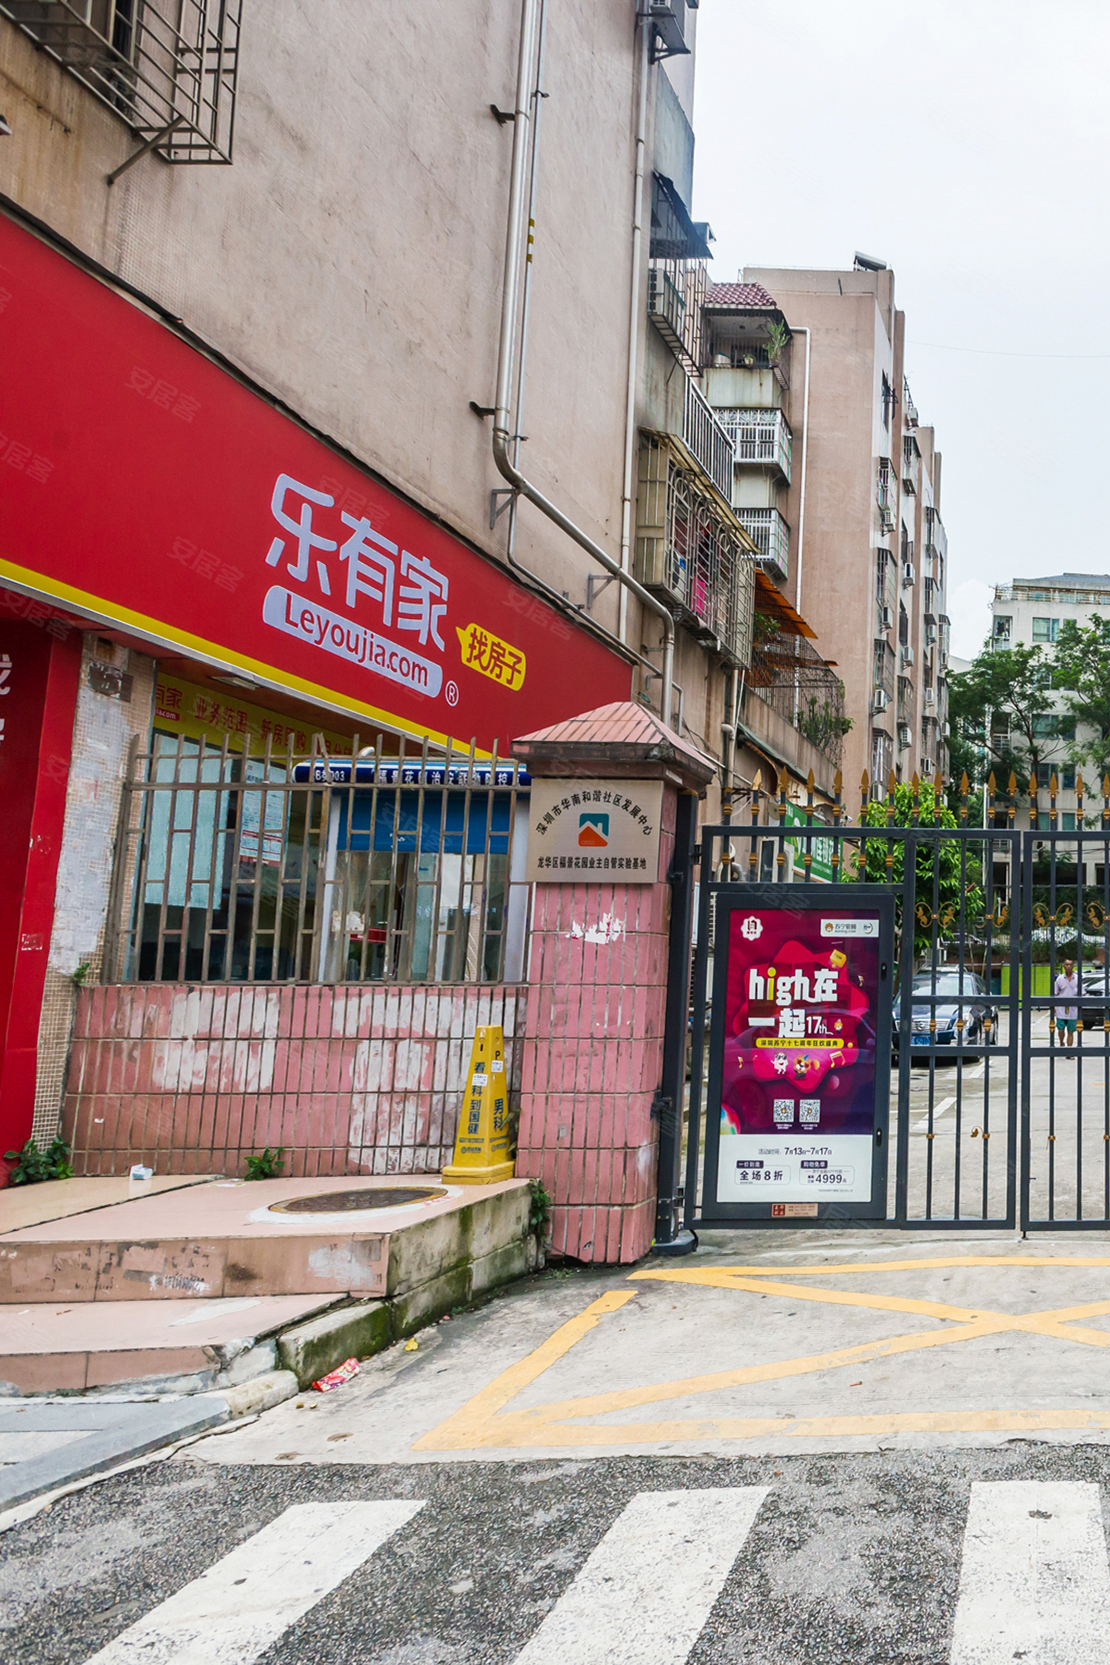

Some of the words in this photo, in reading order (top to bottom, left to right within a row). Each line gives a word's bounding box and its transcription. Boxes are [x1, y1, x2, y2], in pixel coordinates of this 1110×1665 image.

[265, 473, 449, 652] 乐有家
[284, 592, 428, 687] Leyoujia.com
[465, 627, 523, 685] 找房子
[194, 697, 248, 734] 业务范围
[536, 790, 653, 836] 深圳市华南和谐社区发展中心
[537, 856, 647, 870] 龙华区福景花园业主自管实验基地
[467, 1062, 486, 1134] 看科到国健
[493, 1098, 504, 1132] 男科
